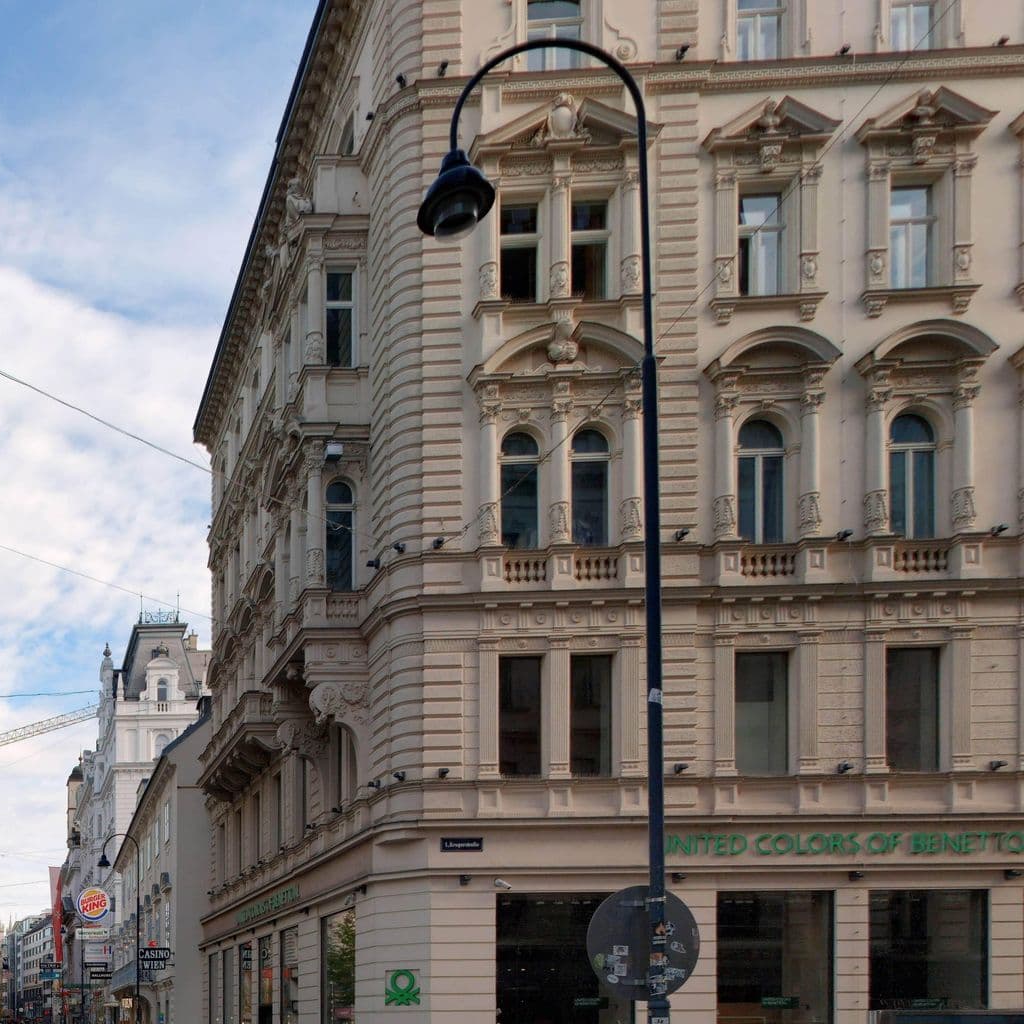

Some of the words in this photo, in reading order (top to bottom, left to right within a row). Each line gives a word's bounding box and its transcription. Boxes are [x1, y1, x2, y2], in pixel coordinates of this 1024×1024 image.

[754, 832, 862, 855] COLORS
[867, 831, 904, 853] OF
[81, 893, 106, 906] BURGER
[82, 900, 107, 913] KING
[139, 949, 170, 959] CASINO
[143, 960, 165, 969] WIEN
